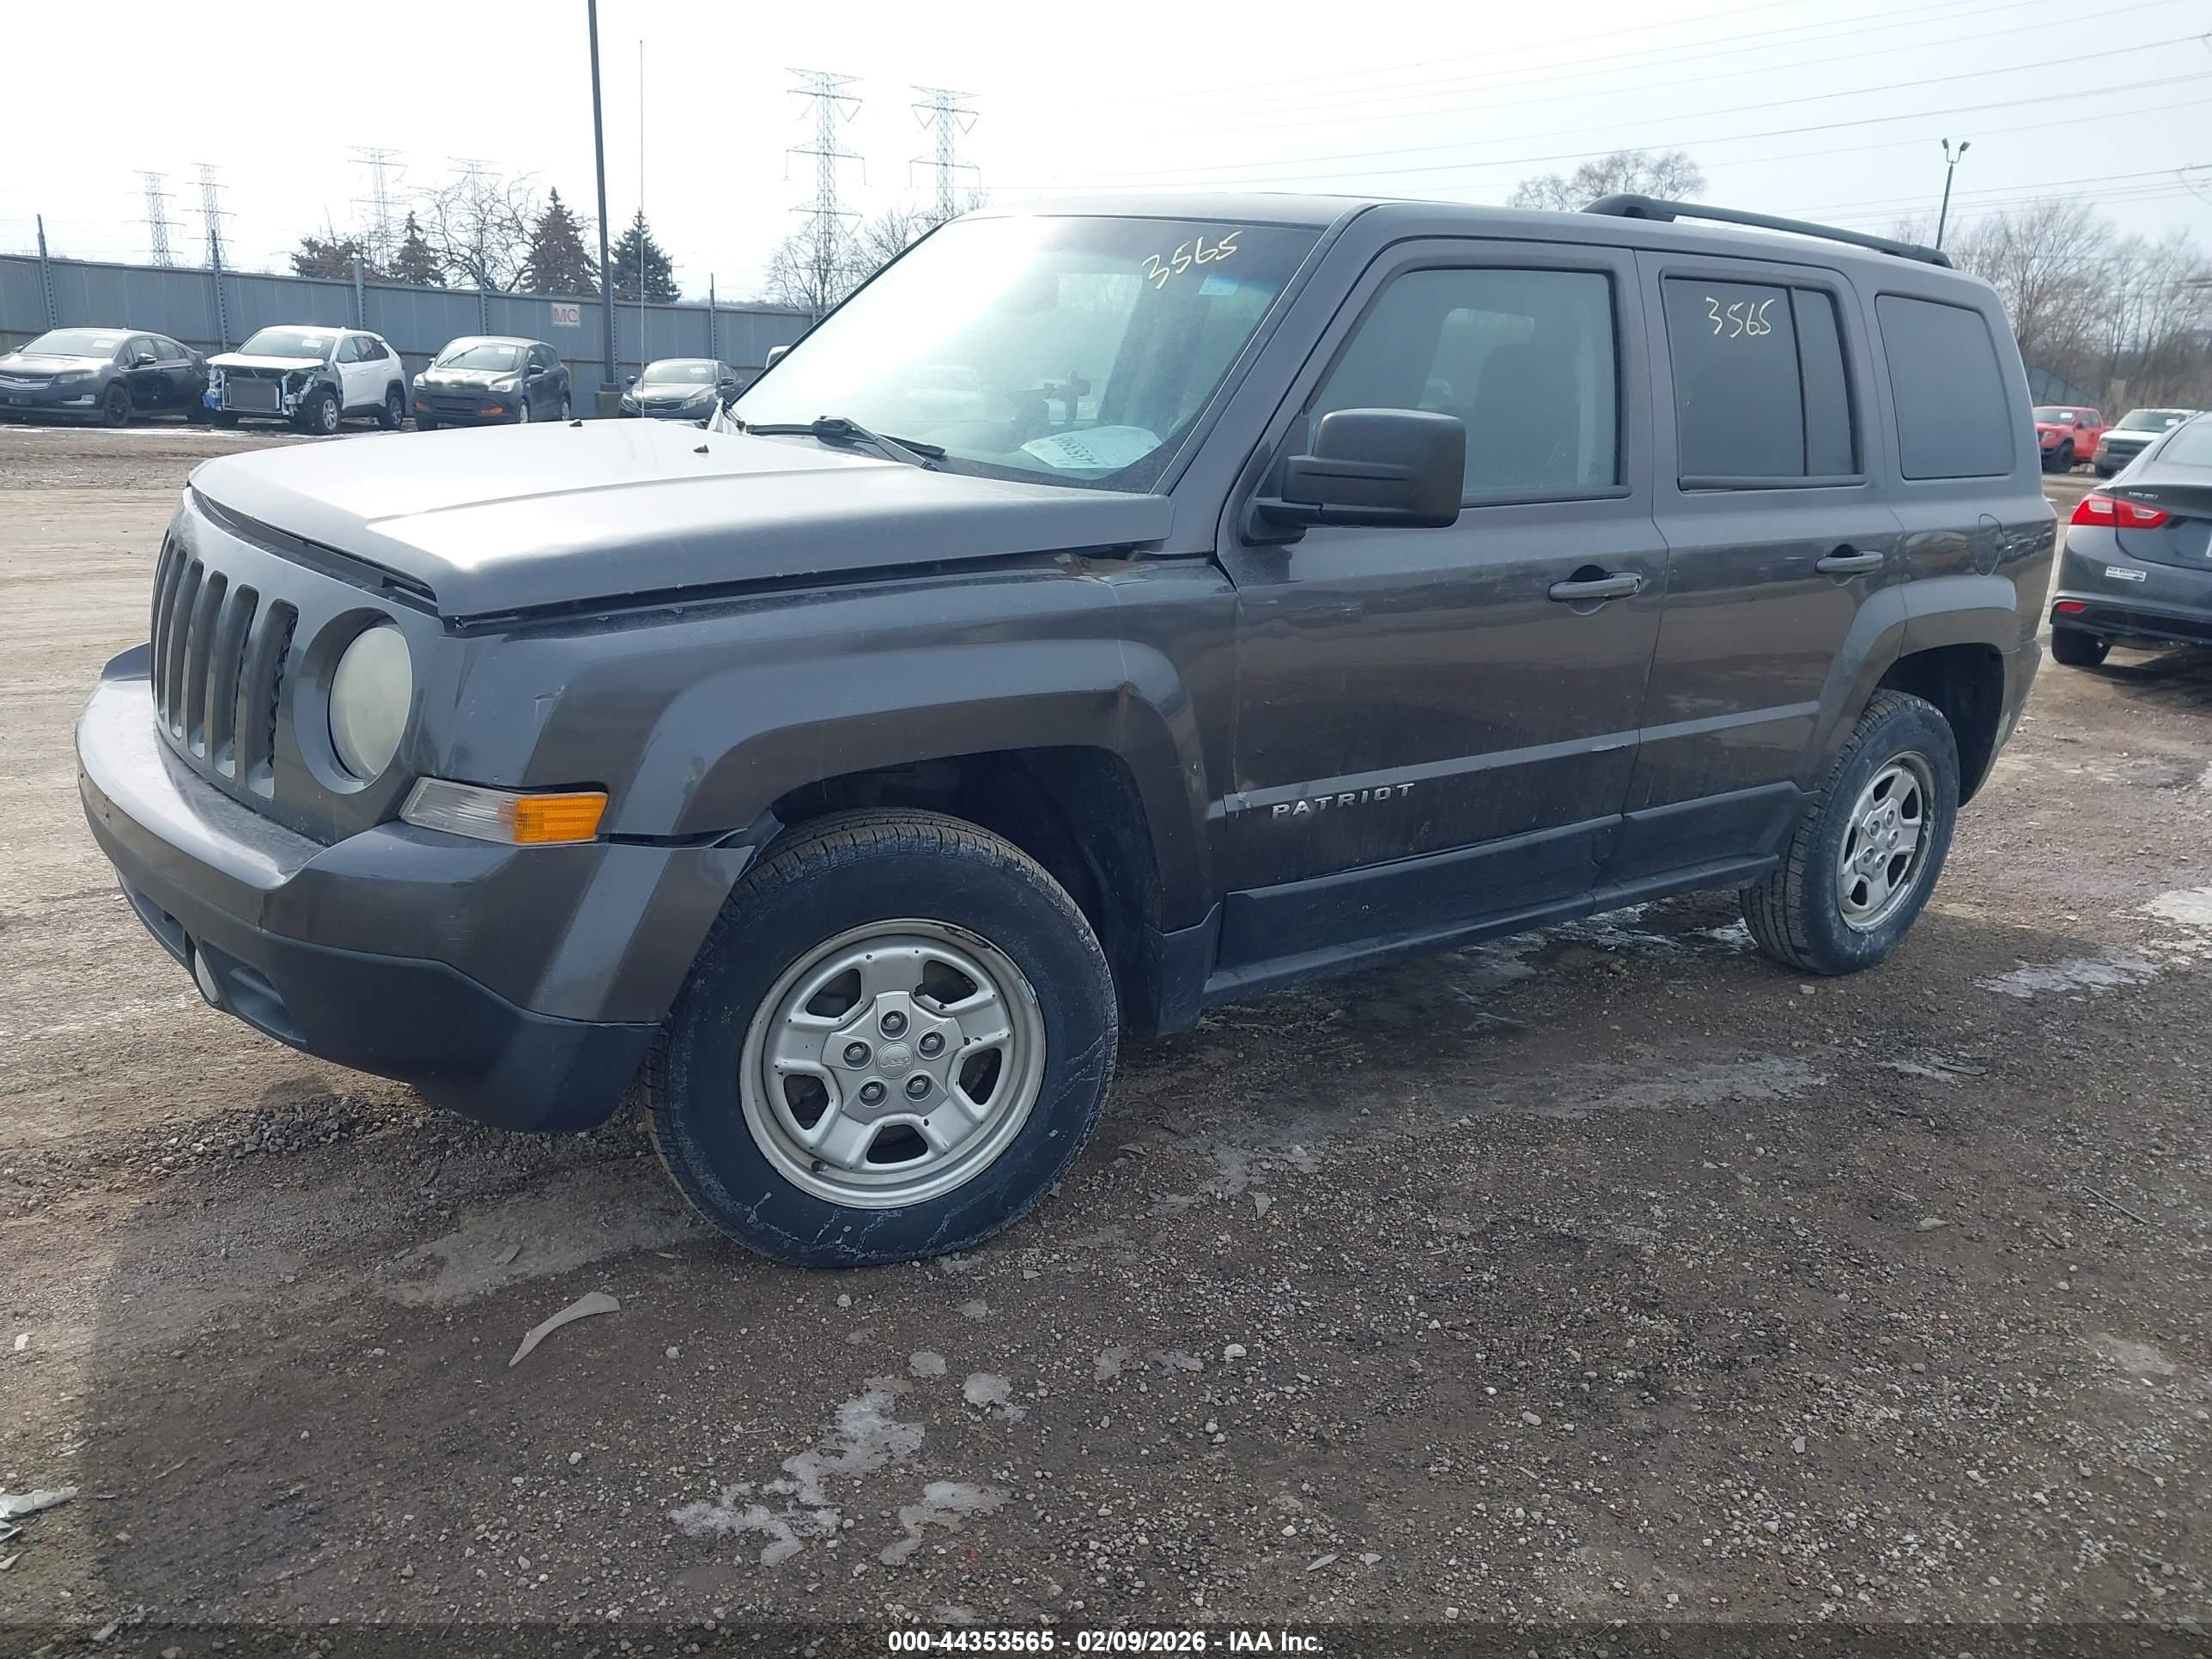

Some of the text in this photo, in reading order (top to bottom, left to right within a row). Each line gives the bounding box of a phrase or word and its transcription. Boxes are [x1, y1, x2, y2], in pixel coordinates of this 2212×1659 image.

[1141, 230, 1243, 289] 3565
[1705, 296, 1775, 338] 3565
[1272, 782, 1415, 819] PATRIOT
[880, 1057, 911, 1068] Jeep
